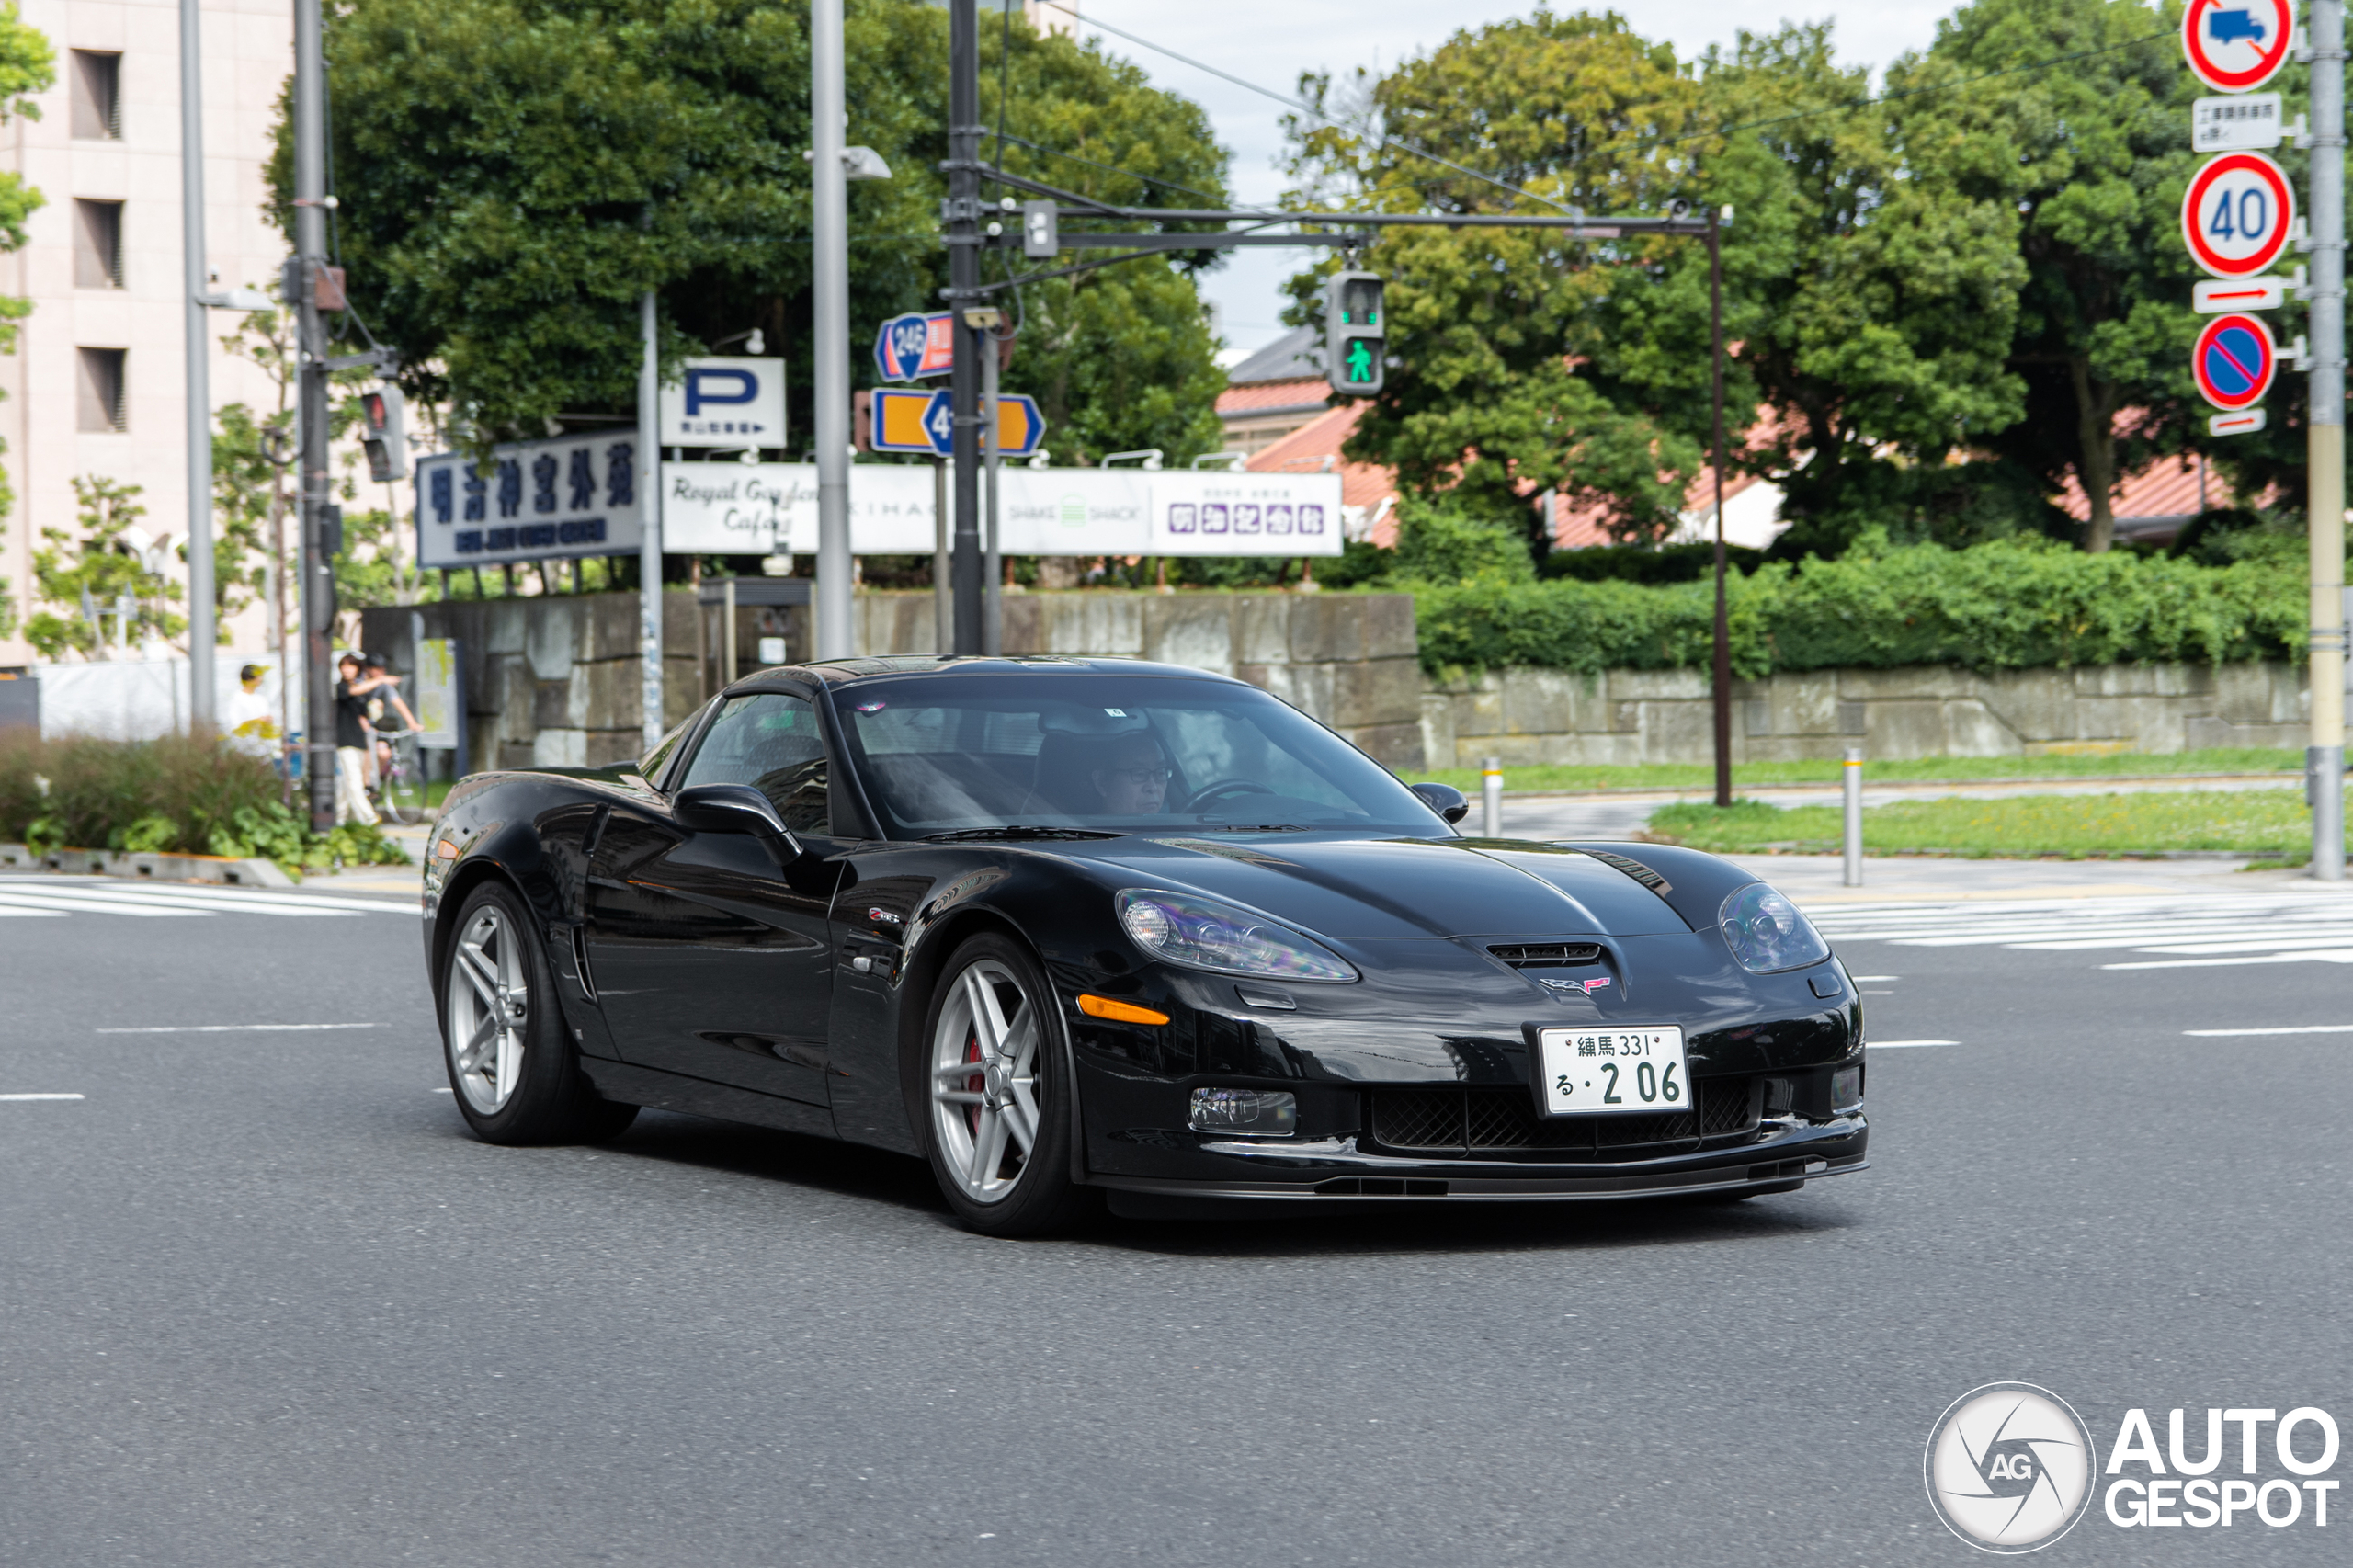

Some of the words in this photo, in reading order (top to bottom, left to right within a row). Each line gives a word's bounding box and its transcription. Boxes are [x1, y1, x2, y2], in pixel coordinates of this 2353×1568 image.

[2210, 189, 2266, 241] 40
[896, 325, 924, 357] 246
[685, 369, 759, 415] P
[932, 405, 954, 439] 4
[673, 476, 739, 506] Royal
[1010, 506, 1054, 520] SHAKE
[1089, 506, 1139, 521] SHACK
[1577, 1036, 1615, 1057] 練馬
[1620, 1035, 1650, 1056] 331
[1556, 1074, 1574, 1096] る
